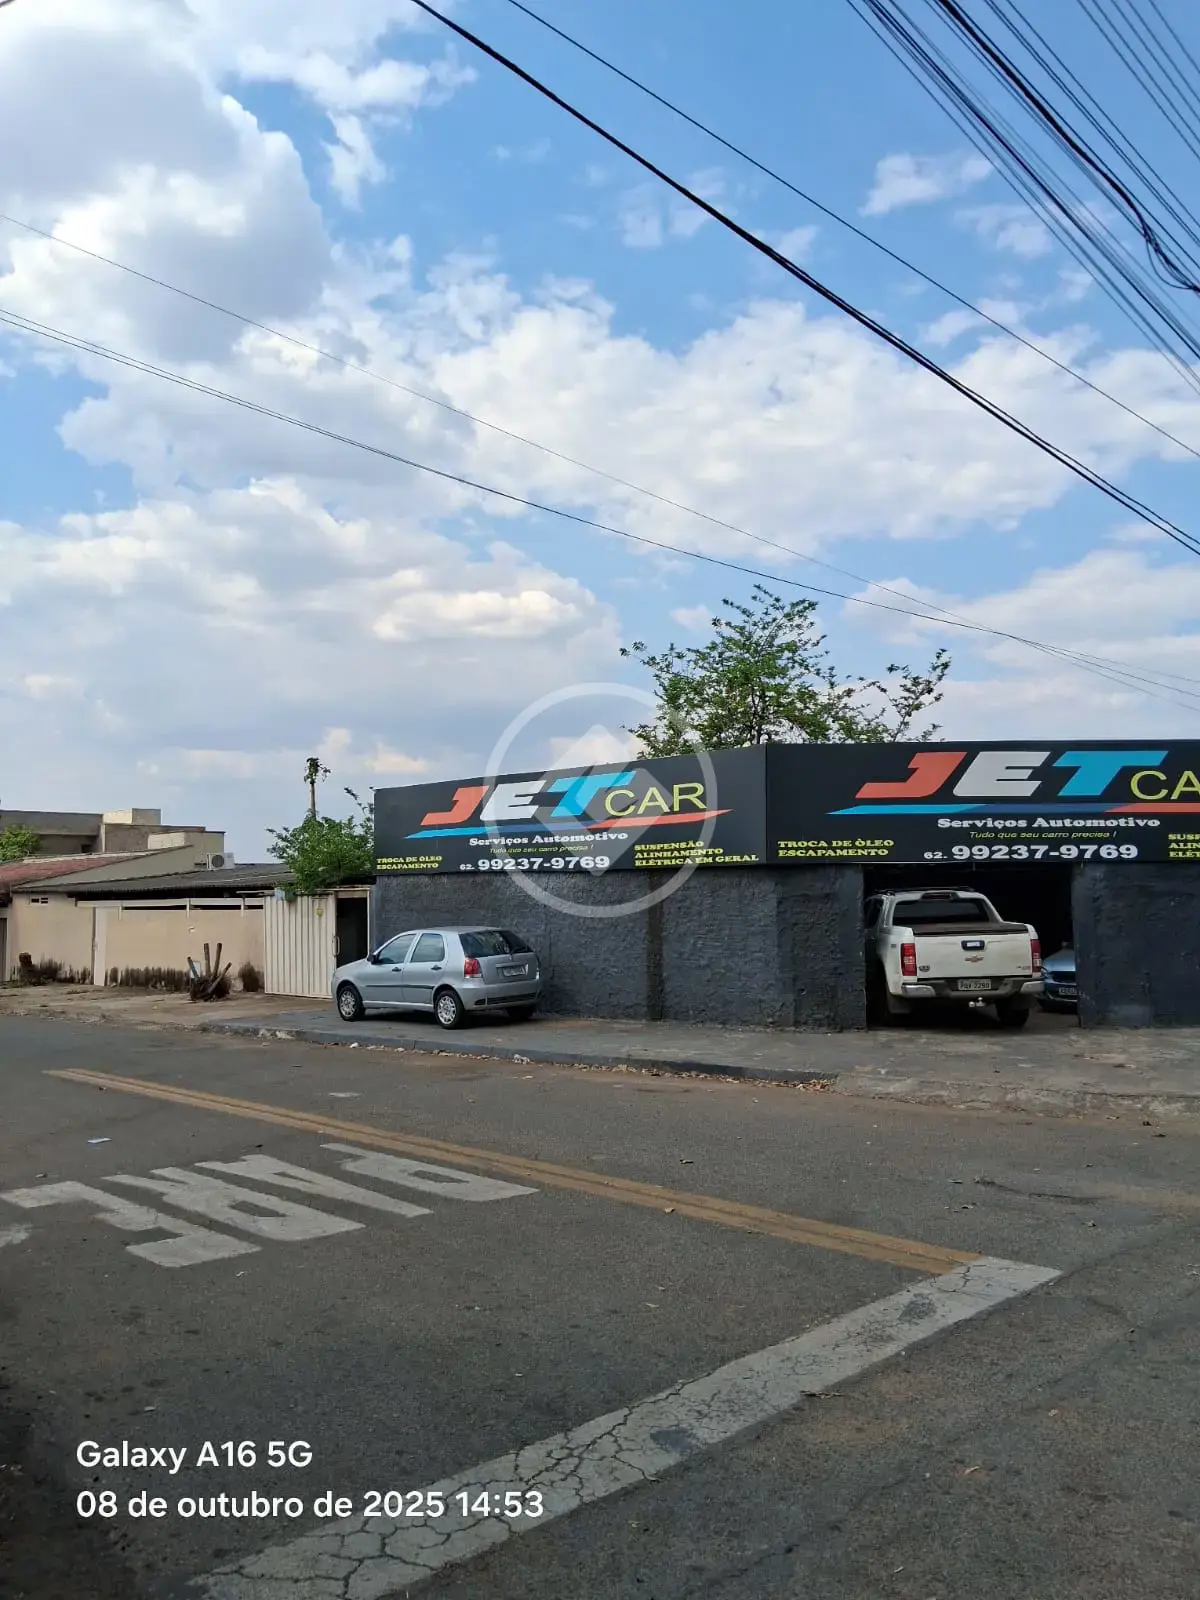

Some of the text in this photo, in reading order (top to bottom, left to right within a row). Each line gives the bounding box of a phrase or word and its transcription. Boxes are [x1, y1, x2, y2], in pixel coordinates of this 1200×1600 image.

[854, 750, 1169, 798] JET
[420, 770, 707, 826] JET CAR
[937, 817, 1160, 829] Serviços Automotivo
[469, 832, 628, 846] Serviços Automotivo
[997, 832, 1017, 840] que
[1071, 831, 1110, 839] precisa
[634, 840, 704, 851] SUSPENSÃO
[778, 840, 828, 848] TROCA
[635, 848, 723, 859] ALINHAMENTO
[778, 849, 888, 857] ESCAPAMENTO
[924, 845, 1138, 859] 62. 99237-9769
[478, 855, 610, 870] 99237-9769
[695, 856, 713, 864] EM
[715, 854, 759, 862] GERAL
[376, 862, 439, 870] ESCAPAMENTO
